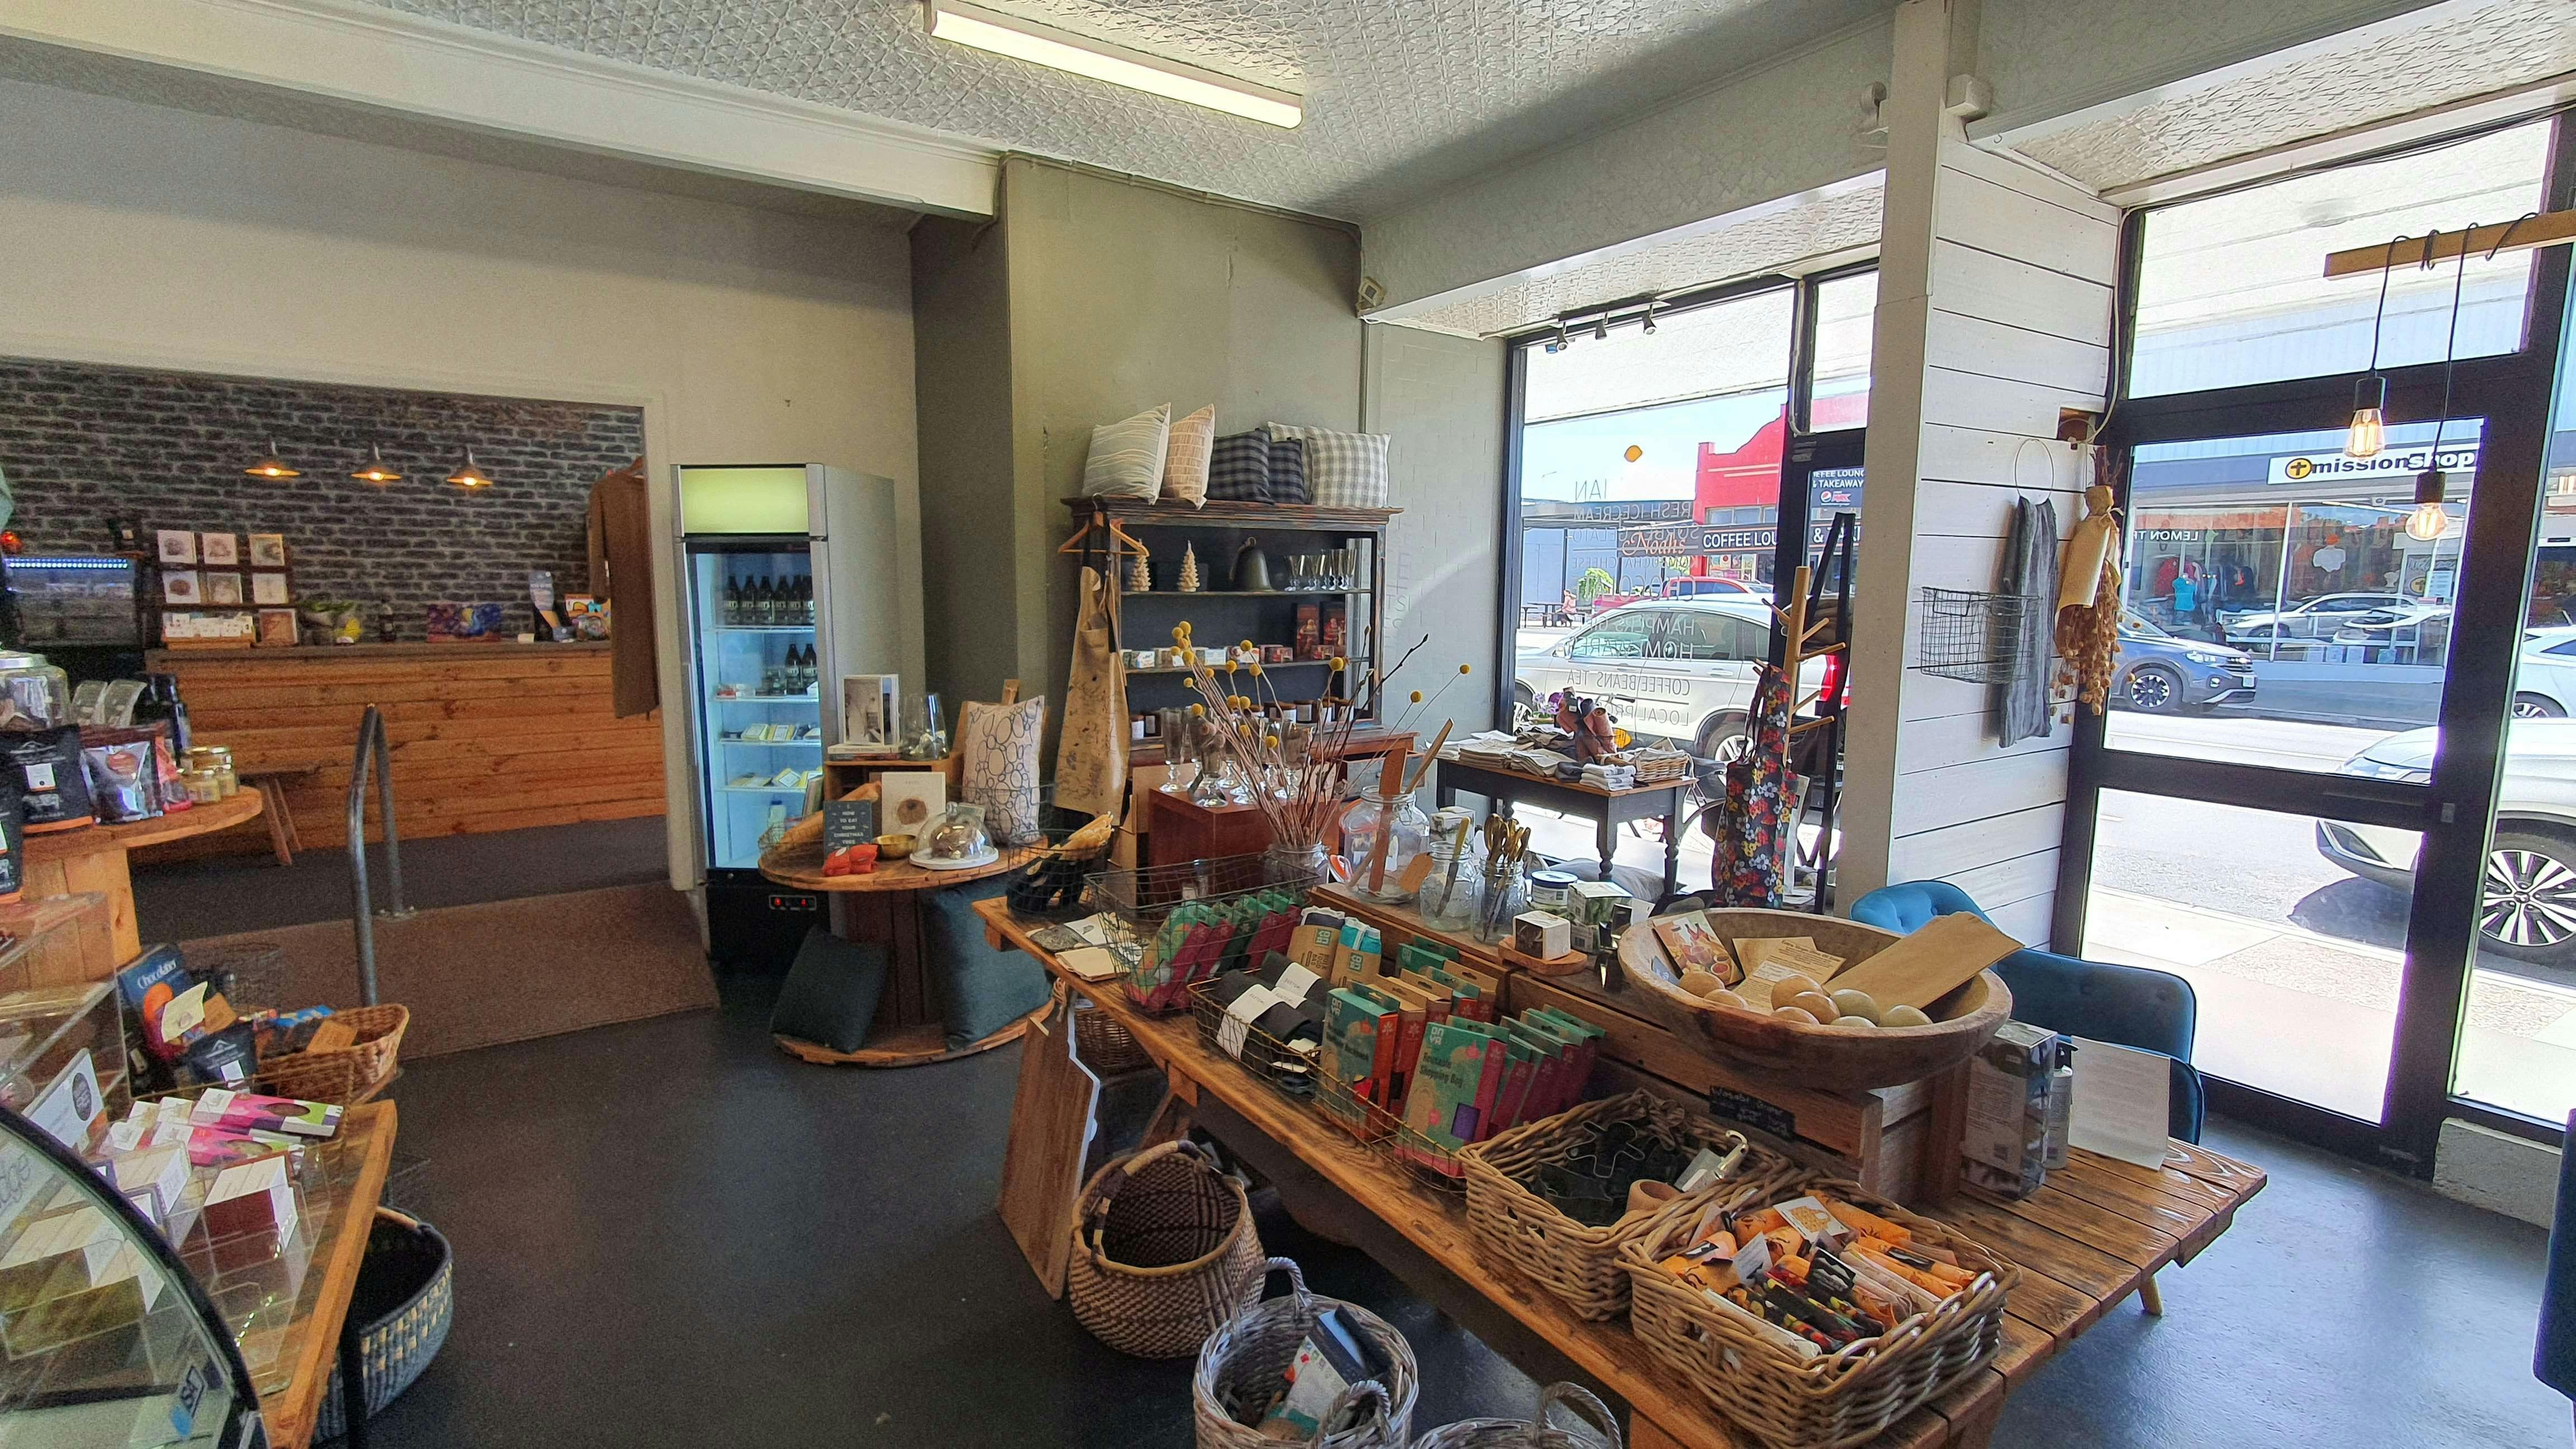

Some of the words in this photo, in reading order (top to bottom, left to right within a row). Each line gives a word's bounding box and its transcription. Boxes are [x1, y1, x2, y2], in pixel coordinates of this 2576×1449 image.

[1818, 479, 1864, 487] TAKEAWAY
[1703, 532, 1751, 548] COFFEE
[1813, 528, 1824, 543] &
